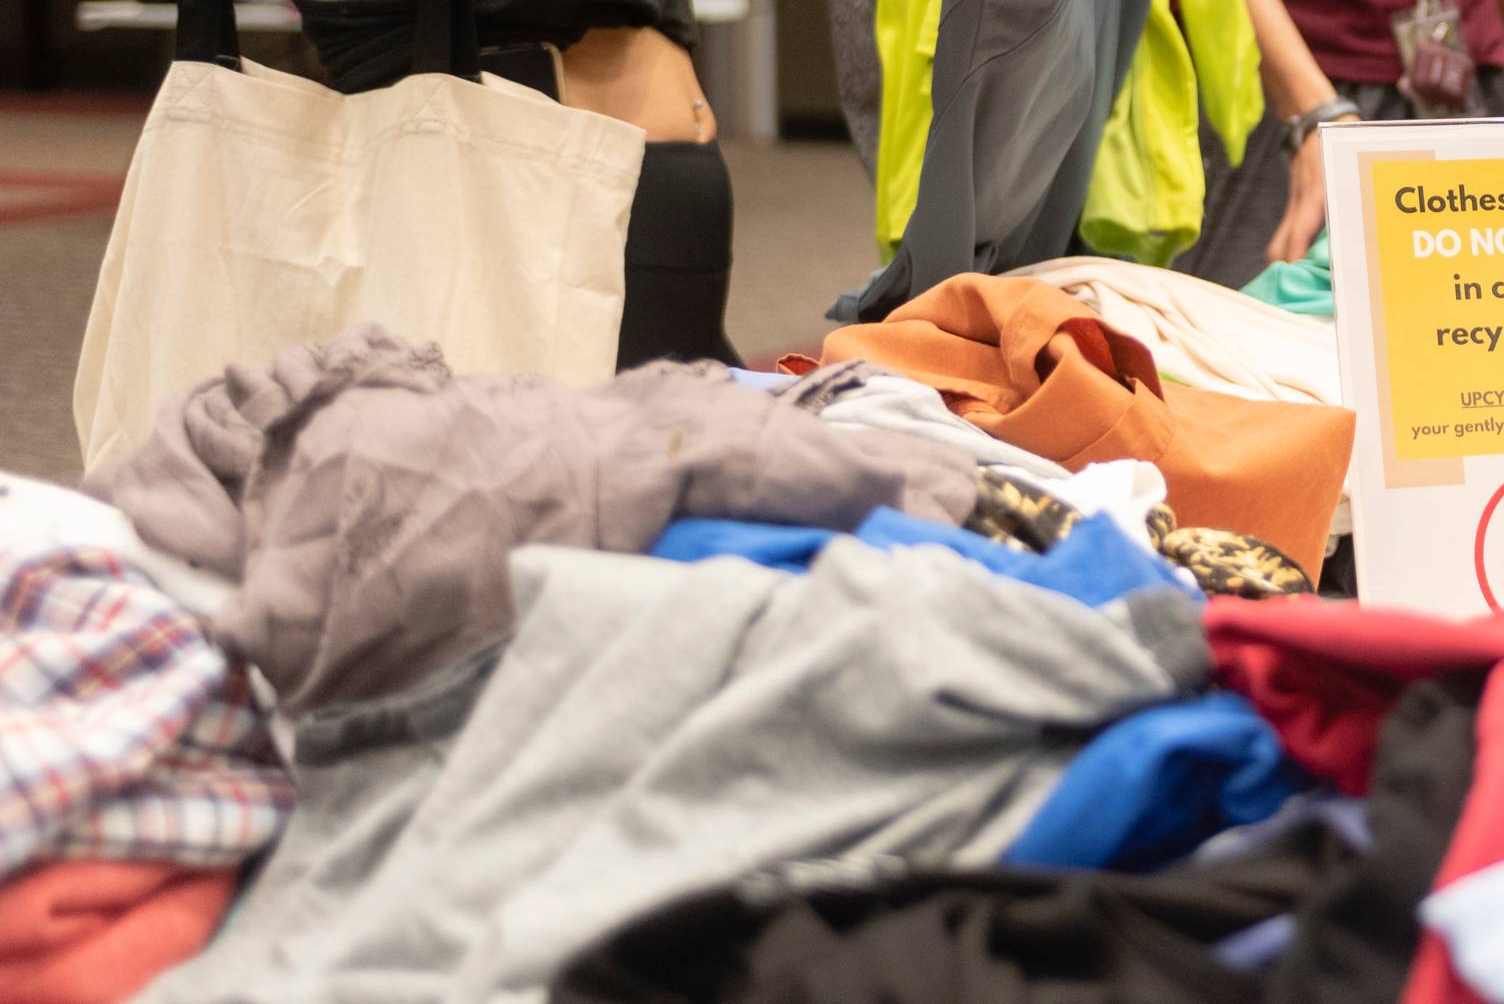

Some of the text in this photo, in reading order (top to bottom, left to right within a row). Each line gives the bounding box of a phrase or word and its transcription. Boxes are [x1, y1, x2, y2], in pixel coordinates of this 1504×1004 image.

[1413, 228, 1462, 259] DO
[1454, 274, 1482, 301] in
[1411, 424, 1449, 438] your
[1454, 416, 1504, 437] gently
